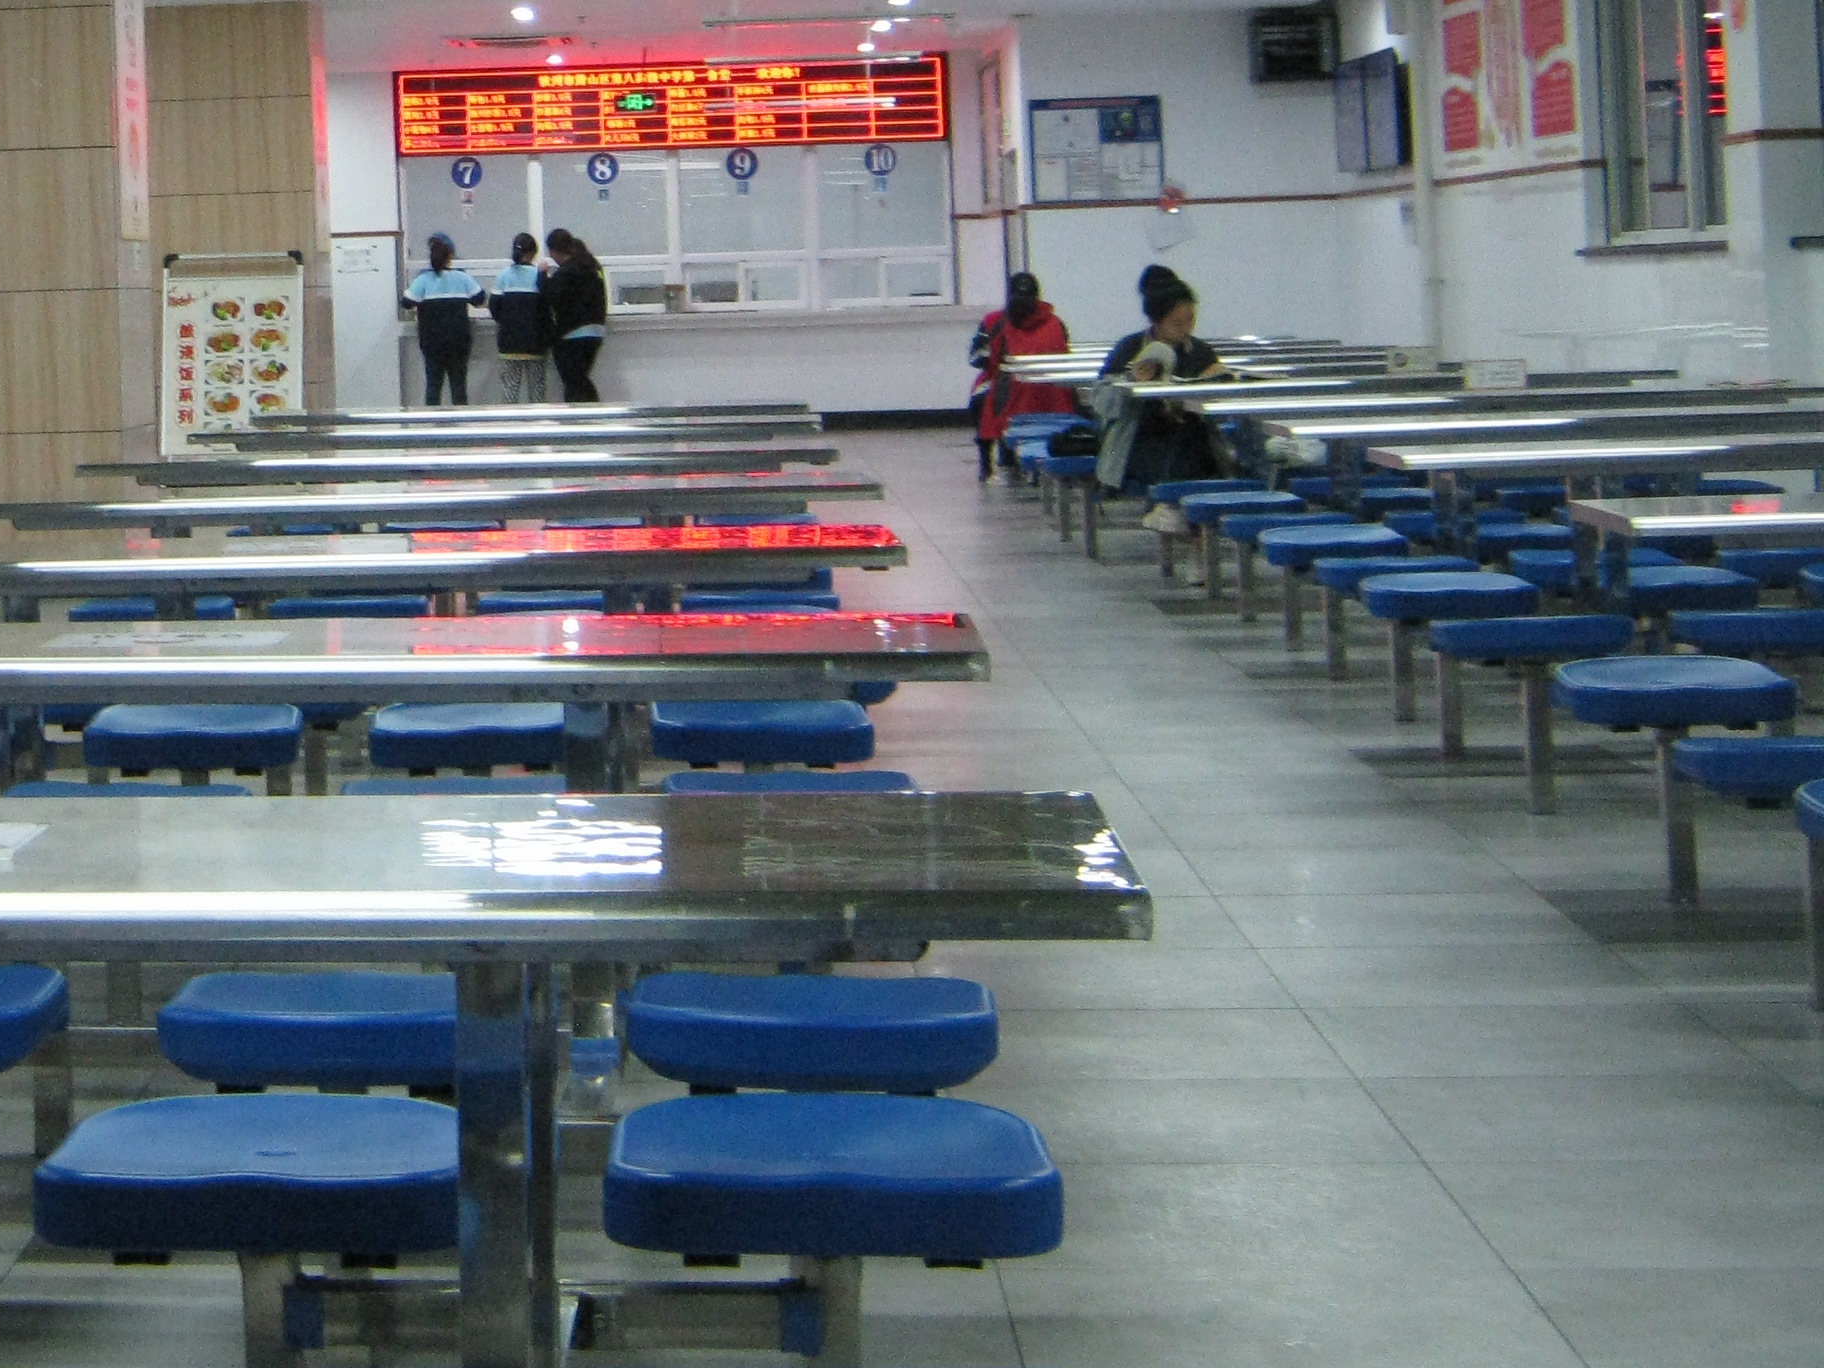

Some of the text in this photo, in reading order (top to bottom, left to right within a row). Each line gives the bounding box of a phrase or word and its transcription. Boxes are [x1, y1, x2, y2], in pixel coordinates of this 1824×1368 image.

[594, 157, 612, 180] 8
[734, 154, 751, 176] 9
[870, 148, 893, 171] 10
[458, 162, 475, 185] 7
